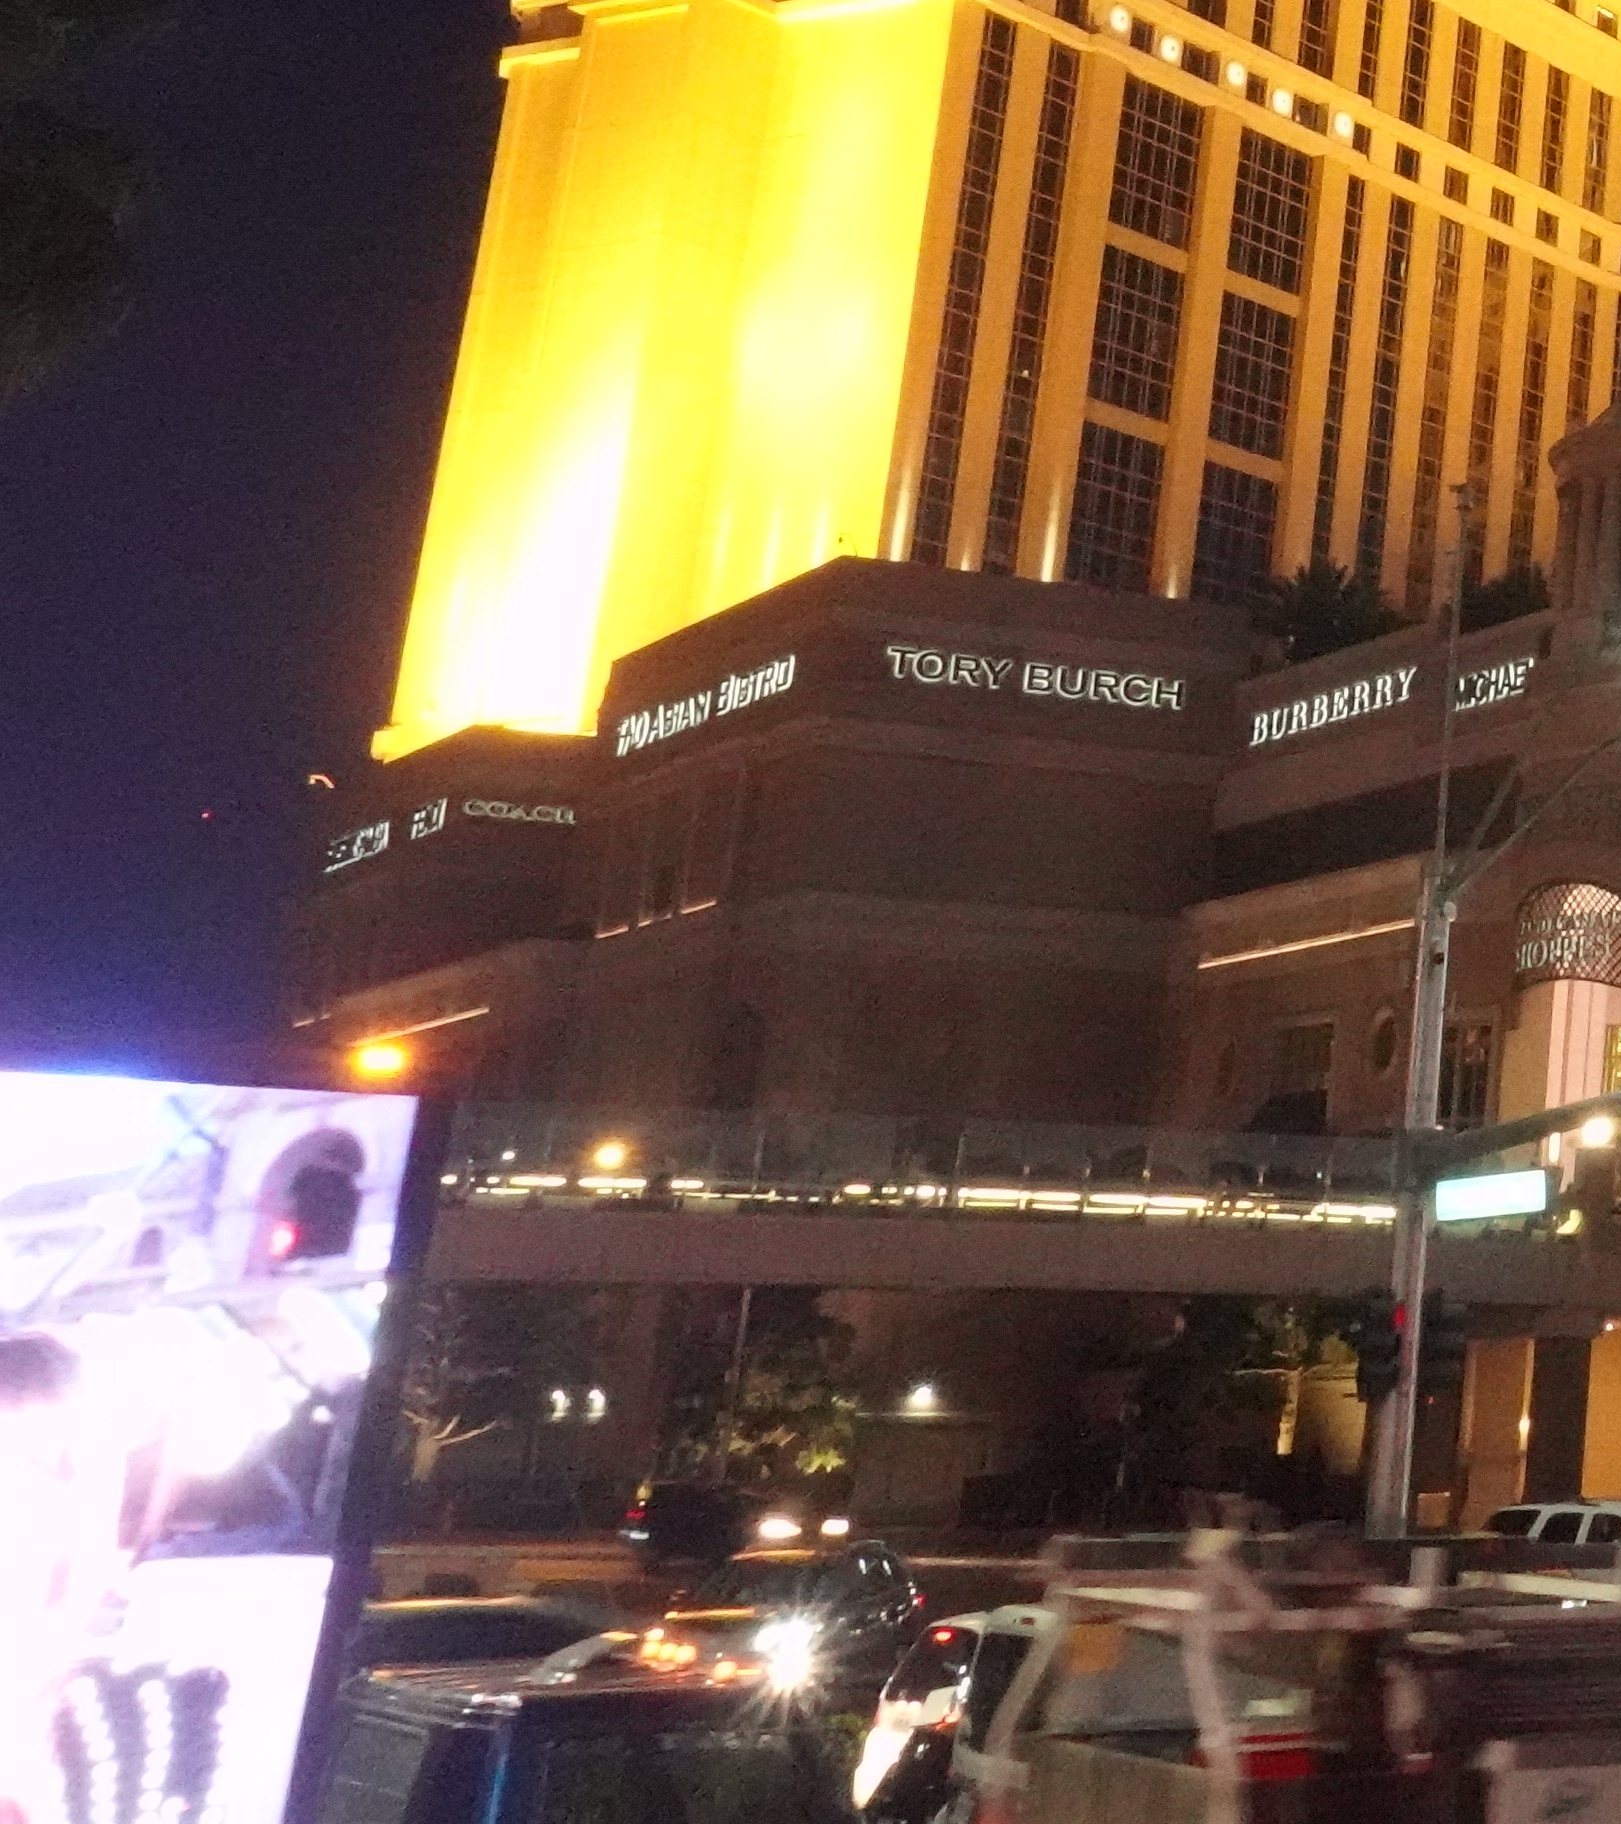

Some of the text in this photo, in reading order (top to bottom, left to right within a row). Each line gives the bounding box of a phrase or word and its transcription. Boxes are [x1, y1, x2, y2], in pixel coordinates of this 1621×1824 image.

[716, 655, 796, 717] BISTRO
[886, 645, 1185, 712] TORY BURCH
[1248, 664, 1418, 747] BURBERRY
[462, 798, 576, 825] COACH
